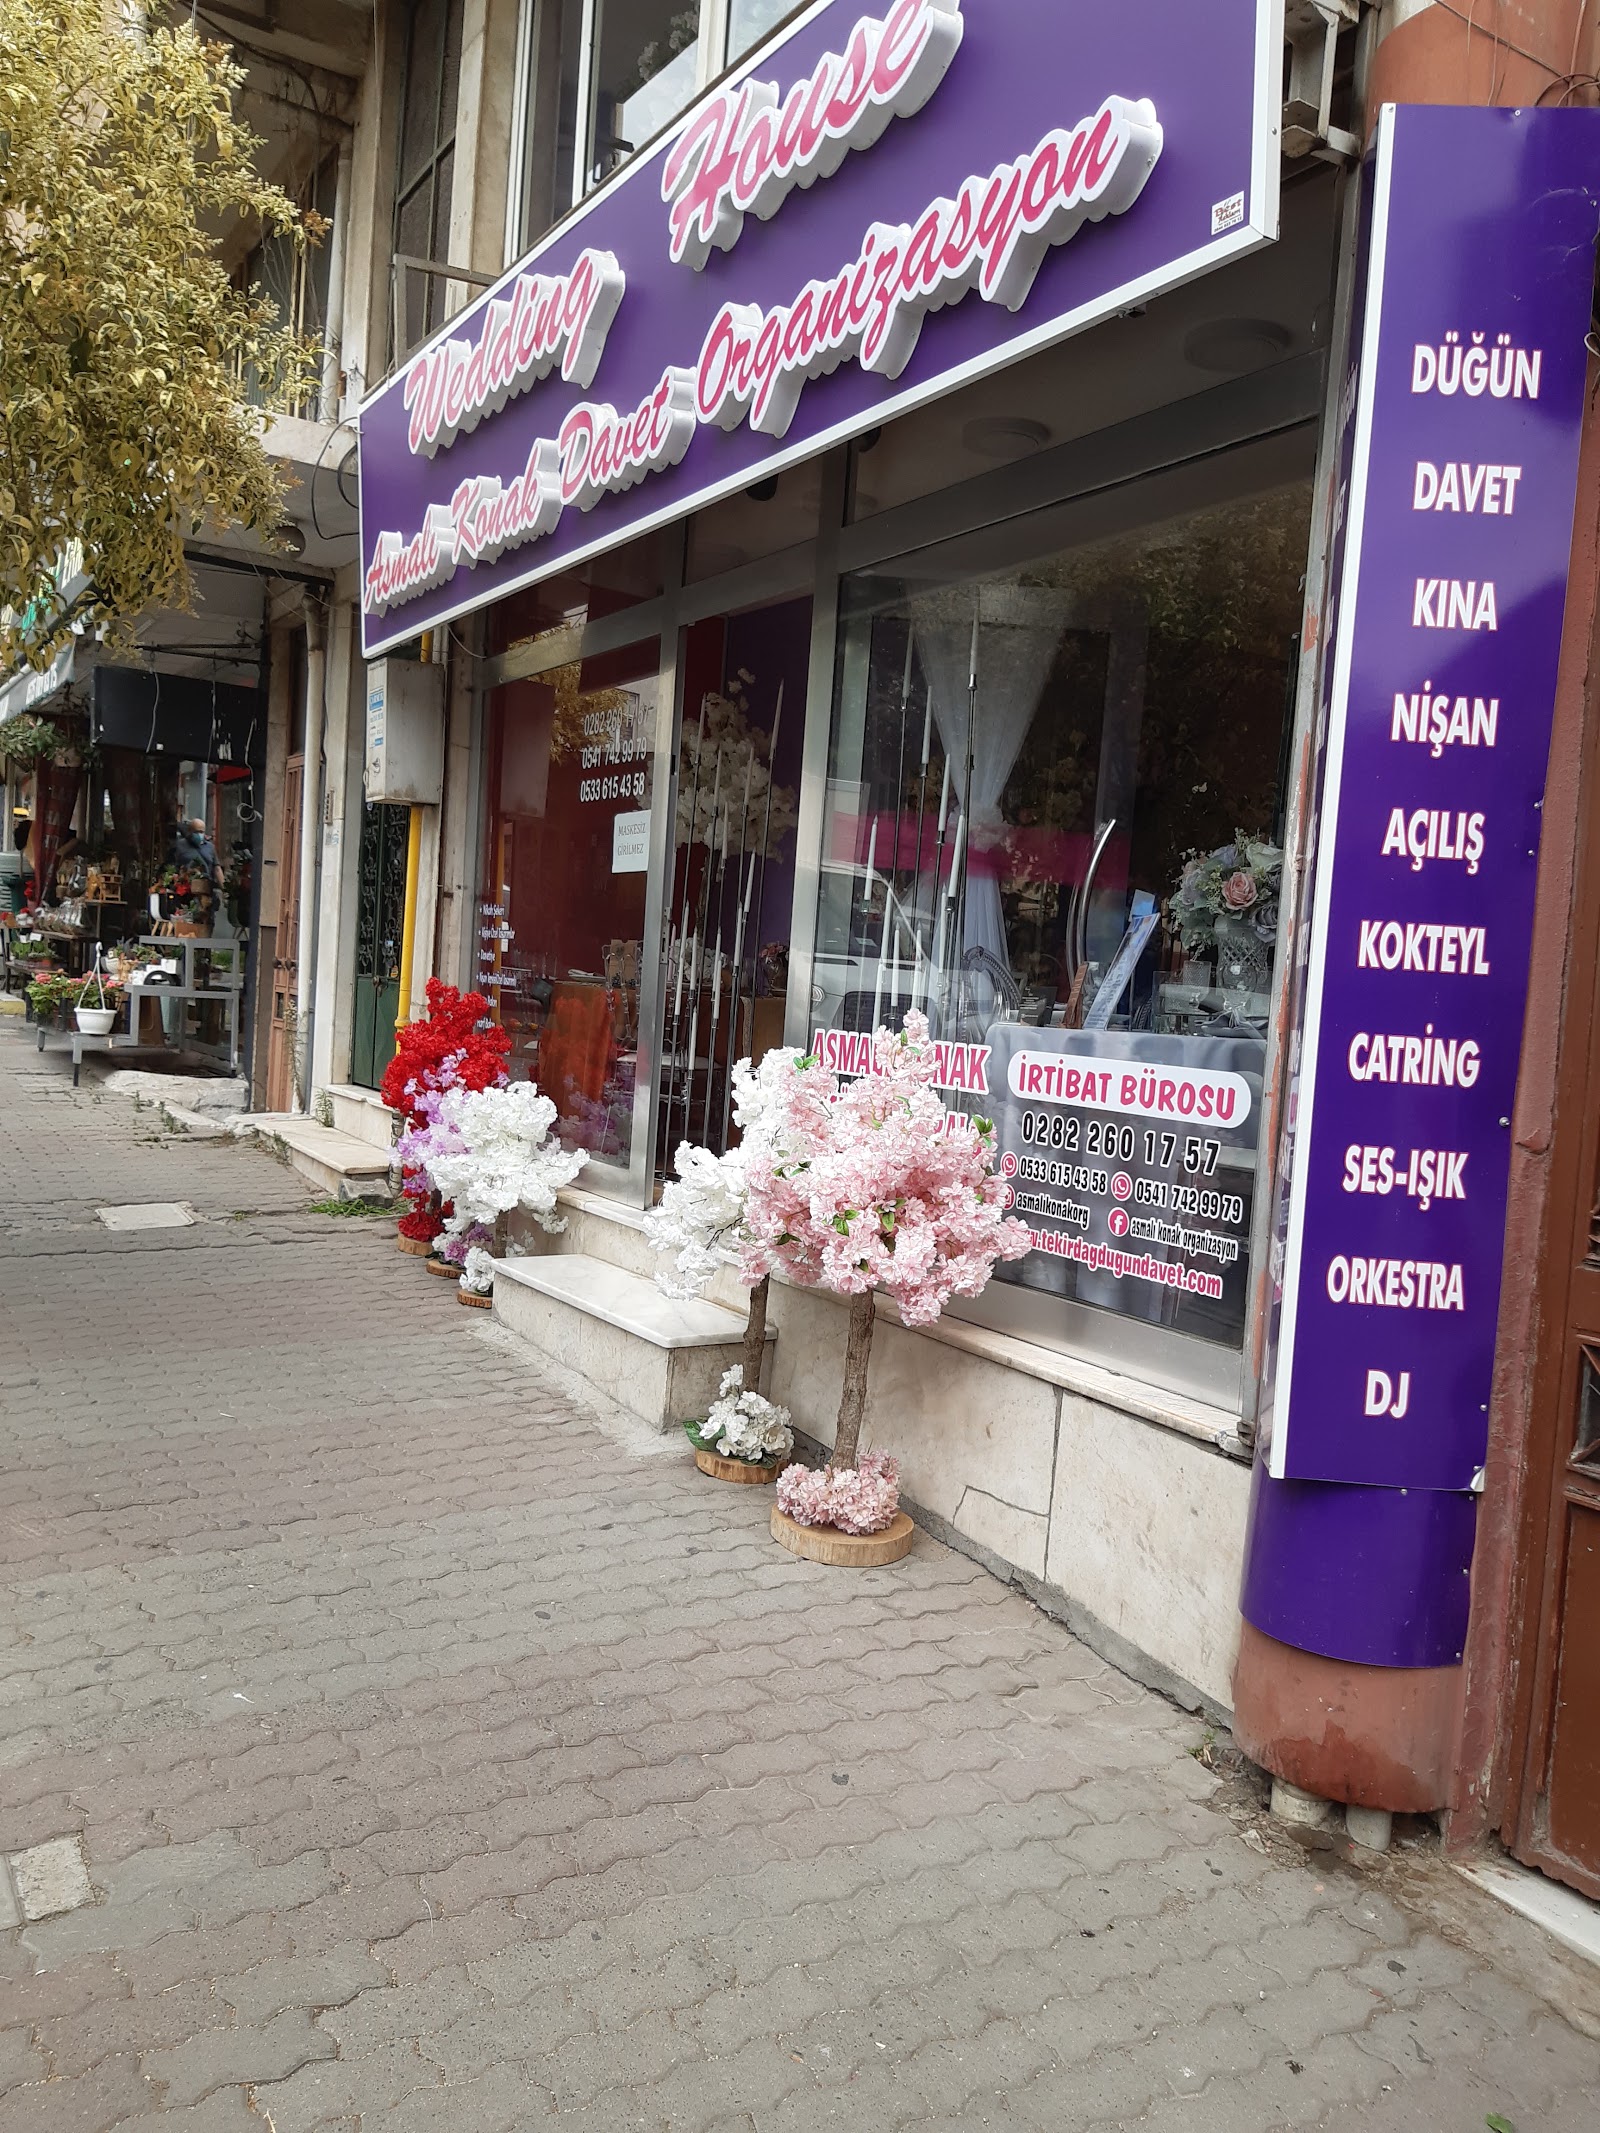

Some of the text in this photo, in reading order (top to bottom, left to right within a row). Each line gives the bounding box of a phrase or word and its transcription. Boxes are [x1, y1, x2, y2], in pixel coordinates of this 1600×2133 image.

[404, 0, 935, 454] Wedding House
[452, 446, 542, 564] Konak
[557, 372, 675, 506] Davet
[697, 98, 1127, 433] Organizasyon
[1411, 330, 1542, 398] DÜĞÜN
[1413, 462, 1521, 515] DAVET
[1412, 578, 1498, 631] KINA
[584, 711, 605, 736] 0282
[1391, 681, 1499, 758] NİŞAN
[582, 737, 647, 770] 0541 742 99 79
[580, 773, 645, 802] 0533 615 43 58
[617, 843, 644, 857] GİRİLMEZ
[618, 821, 646, 837] MASKESİZ
[1383, 808, 1486, 874] AÇILIŞ
[1357, 920, 1491, 976] KOKTEYL
[812, 1031, 890, 1078] ASMAL
[1348, 1024, 1480, 1088] CATRİNG
[1019, 1055, 1236, 1121] İRTİBAT BÜROSU
[1021, 1112, 1079, 1149] 0282
[1087, 1122, 1134, 1160] 260
[1145, 1131, 1175, 1166] 17
[1185, 1139, 1219, 1174] 57
[1020, 1158, 1106, 1194] 0533 615 43 58
[1136, 1180, 1242, 1222] 0541 742 99 79
[1342, 1144, 1469, 1210] SES-IŞIK
[1158, 1221, 1180, 1246] konak
[1183, 1231, 1237, 1262] organizasyon
[1327, 1255, 1465, 1310] ORKESTRA
[1364, 1370, 1410, 1418] DJ
